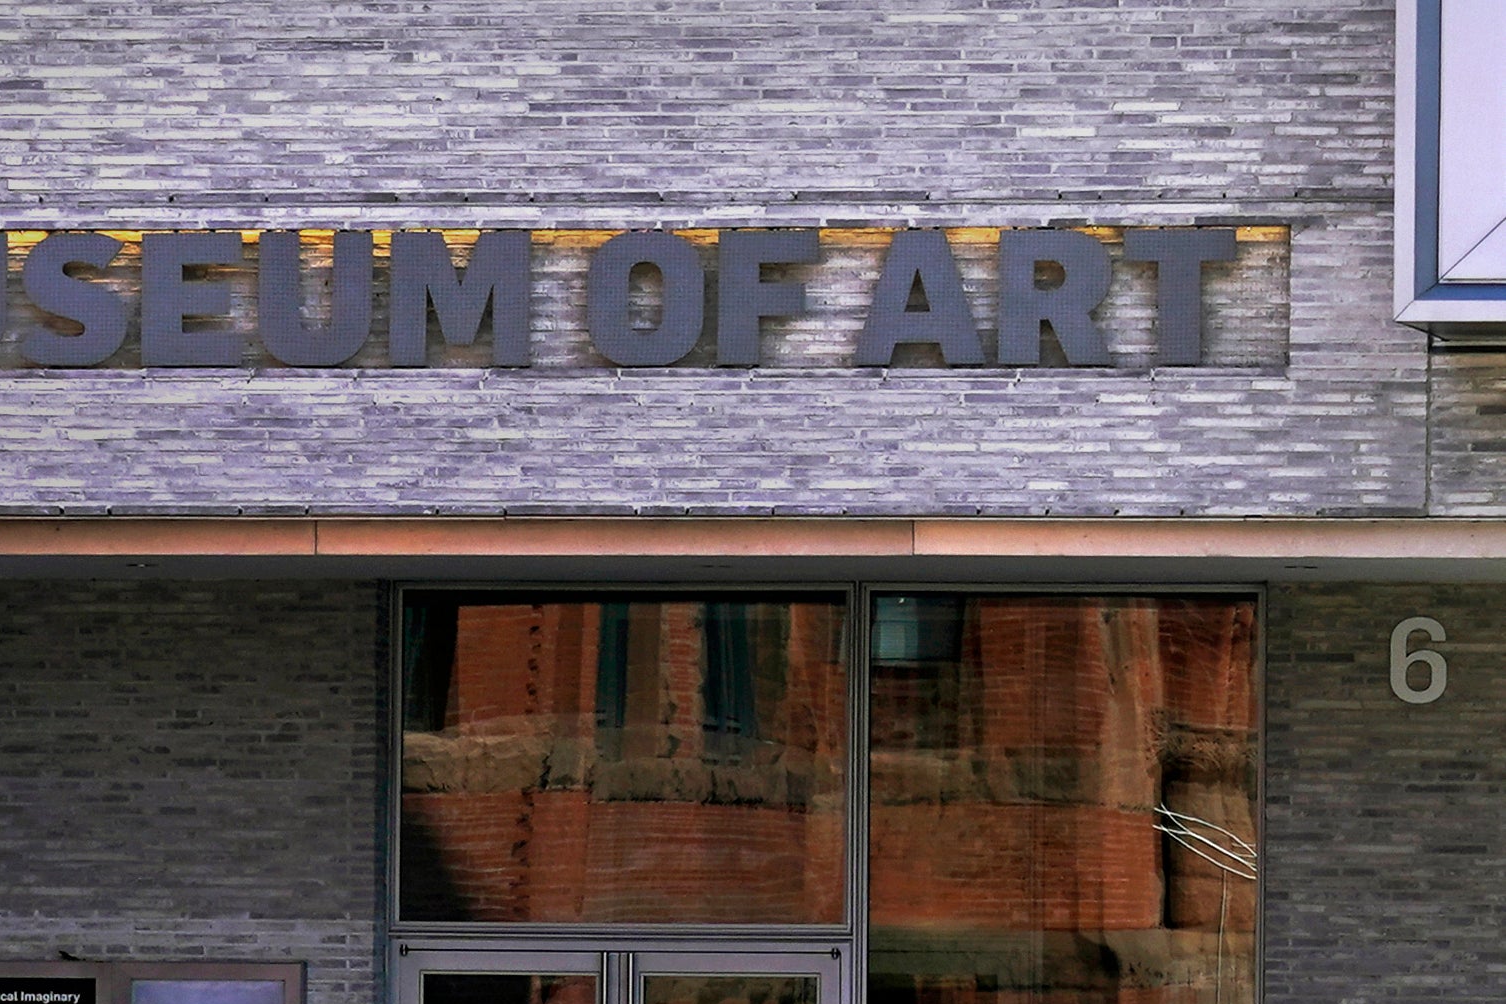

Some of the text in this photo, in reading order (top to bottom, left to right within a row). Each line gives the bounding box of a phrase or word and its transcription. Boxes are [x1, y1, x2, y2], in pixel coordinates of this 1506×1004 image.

[587, 228, 820, 366] OF
[855, 226, 1237, 366] ART
[1390, 616, 1448, 704] 6
[20, 990, 81, 1004] Imaginary
